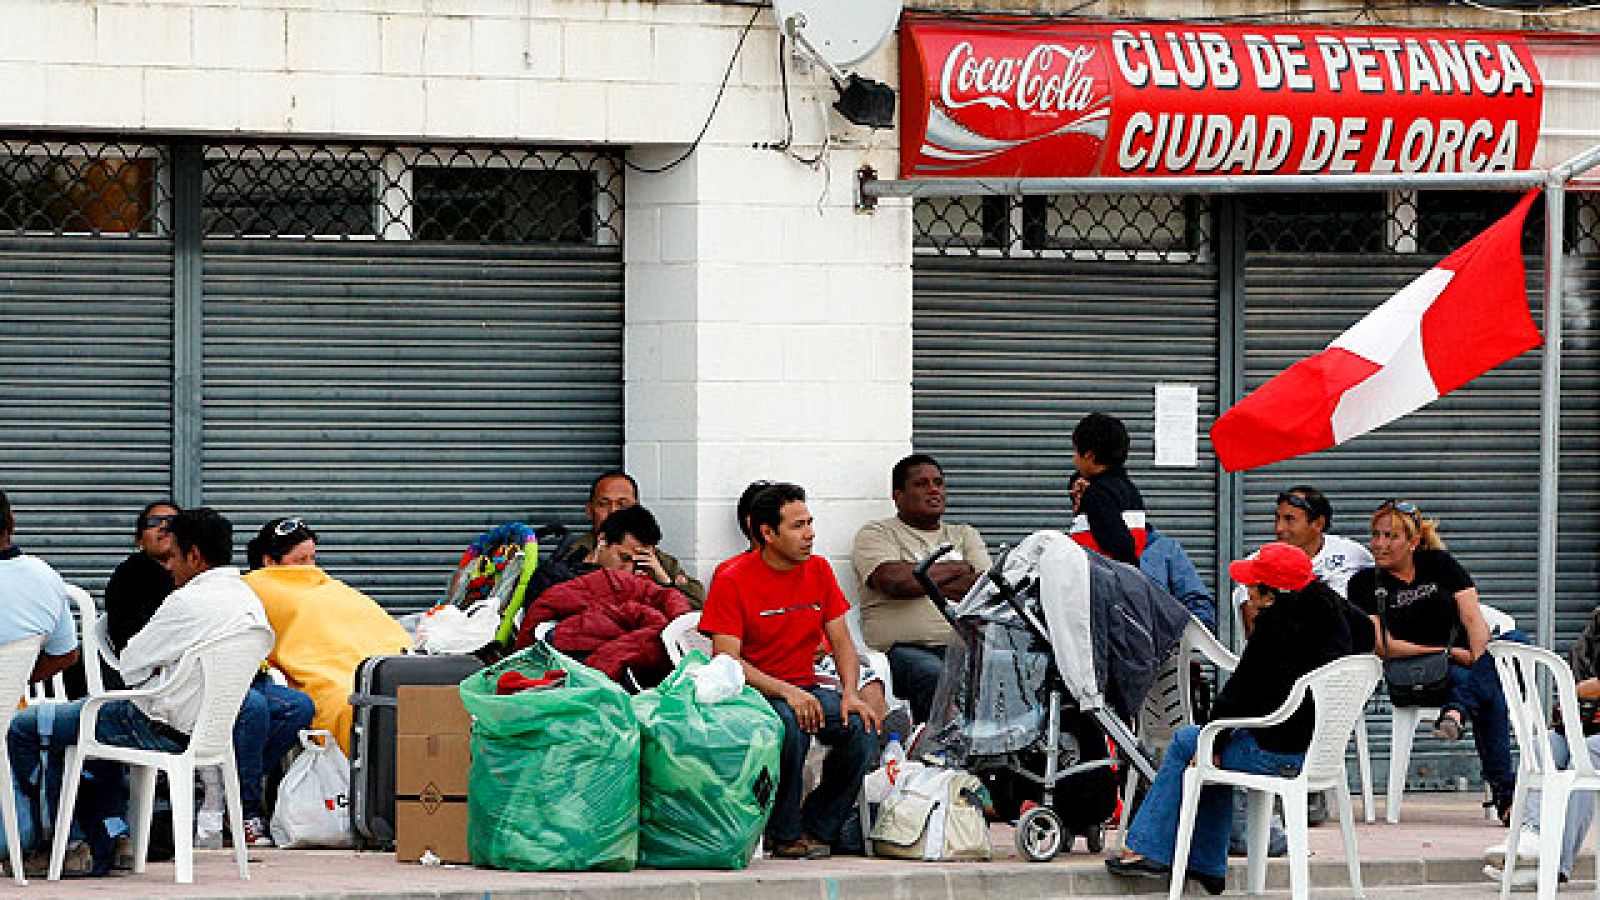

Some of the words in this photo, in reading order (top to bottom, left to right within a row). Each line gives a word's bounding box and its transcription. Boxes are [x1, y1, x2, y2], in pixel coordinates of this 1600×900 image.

[941, 41, 1096, 110] Coca-Cola
[1112, 30, 1240, 90] CLUB
[1243, 34, 1315, 91] DE
[1315, 36, 1534, 96] PETANCA
[1118, 112, 1293, 171] CIUDAD
[1298, 116, 1367, 173] DE
[1370, 117, 1518, 172] LORCA
